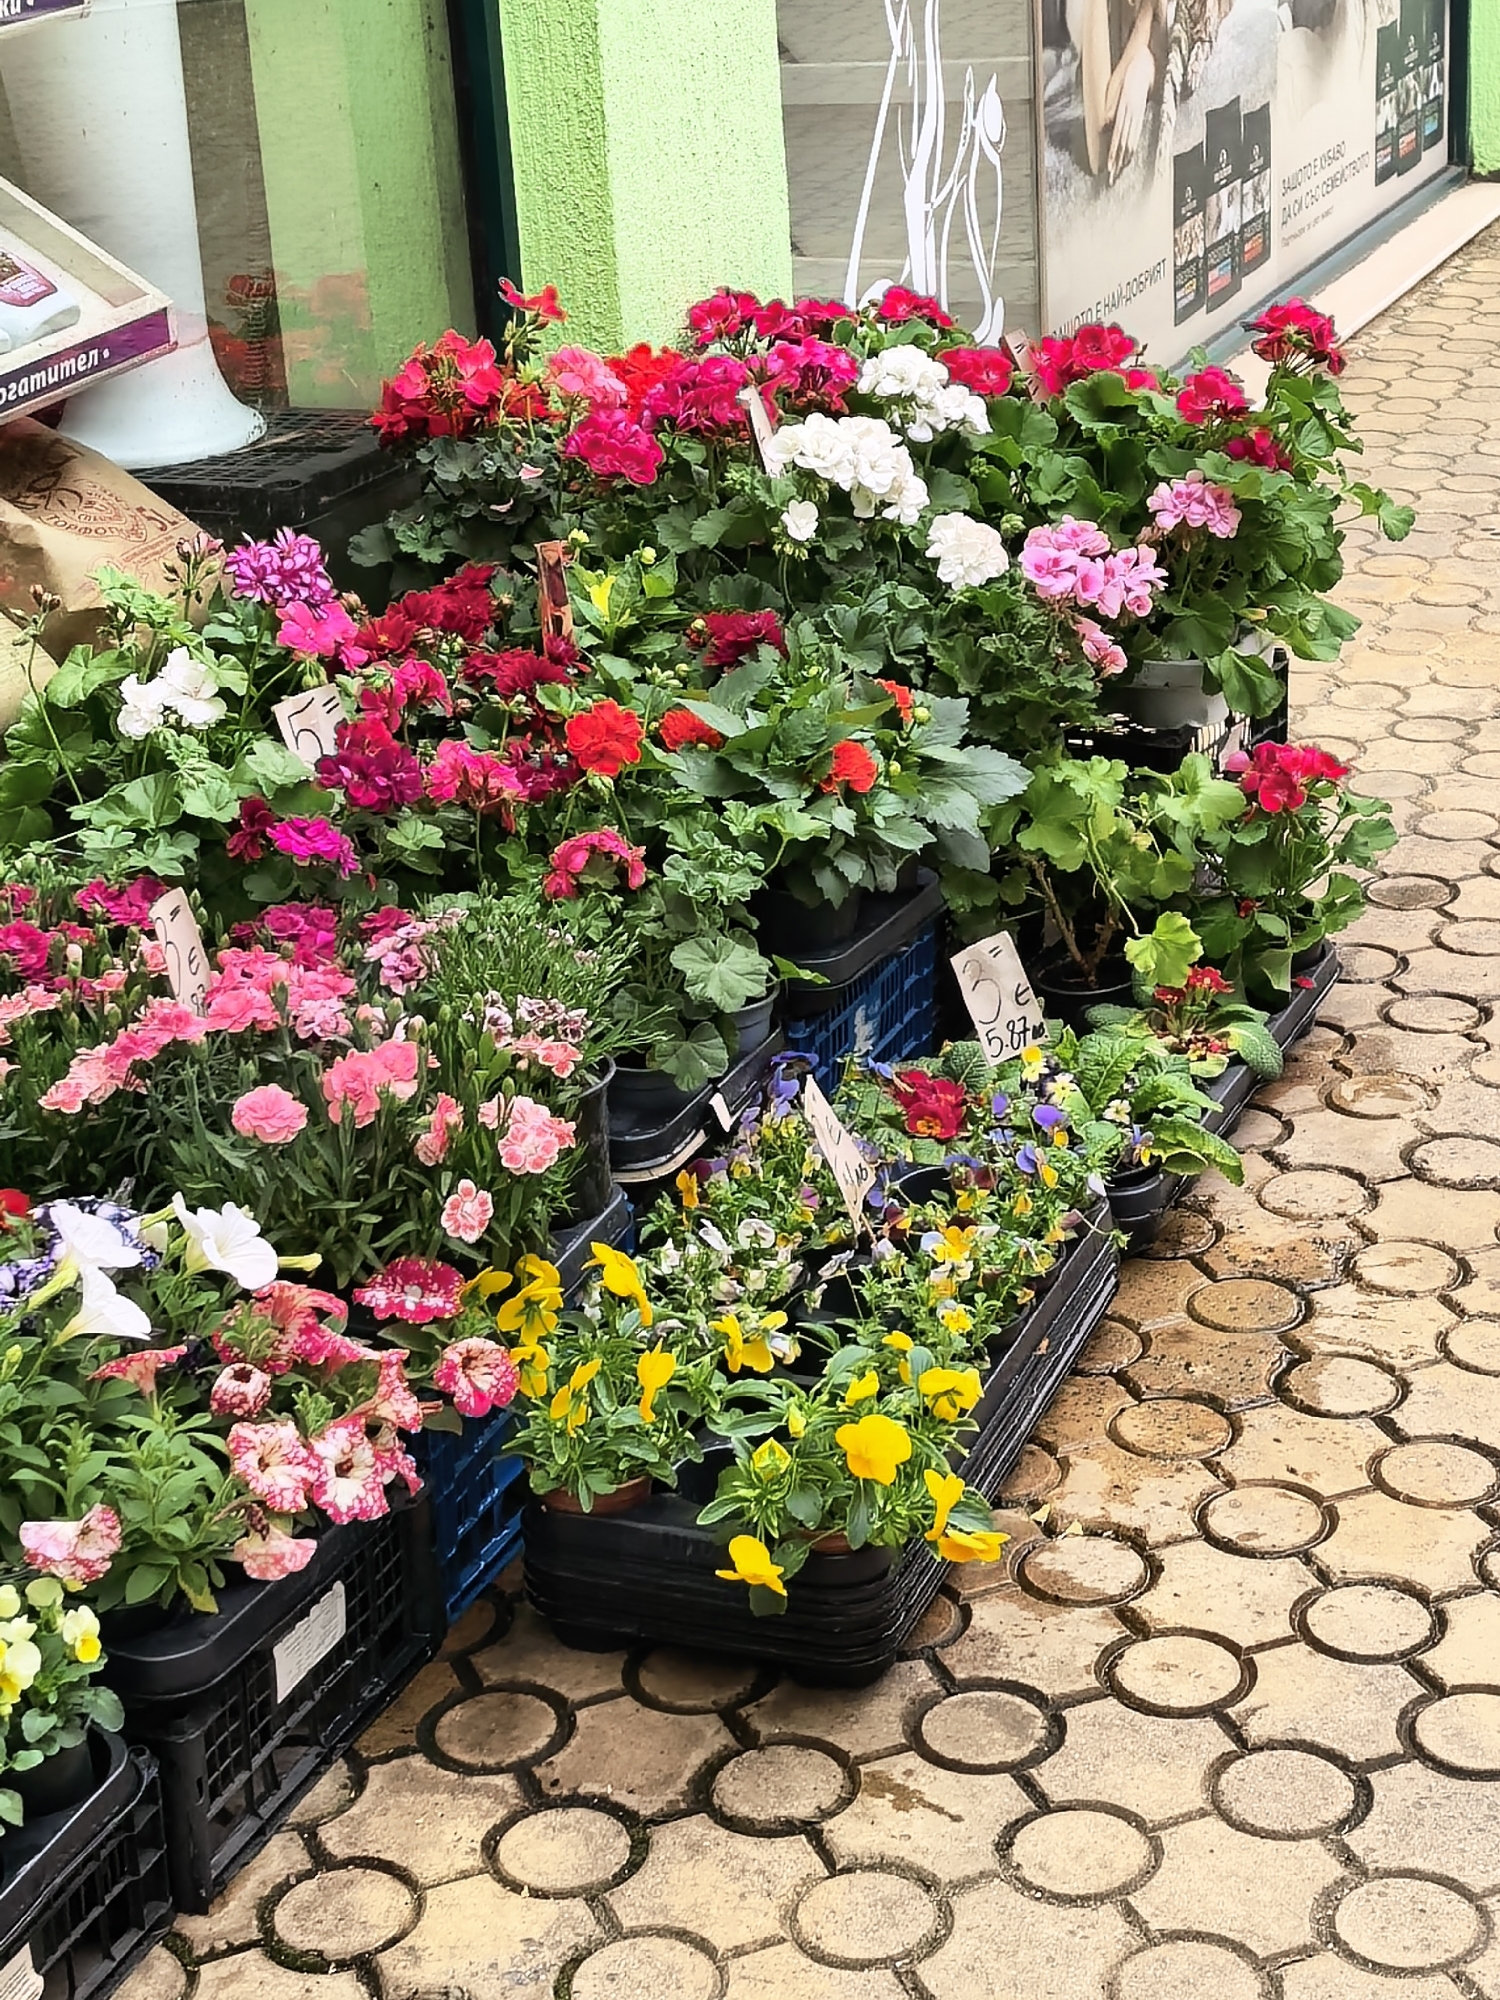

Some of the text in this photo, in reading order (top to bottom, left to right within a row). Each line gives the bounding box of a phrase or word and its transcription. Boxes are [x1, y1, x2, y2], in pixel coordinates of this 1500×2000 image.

[1281, 204, 1292, 230] ДА
[1292, 195, 1303, 217] СИ
[1304, 185, 1320, 209] СЪС
[1104, 257, 1166, 317] НАЙ-ДОБРИЯТ
